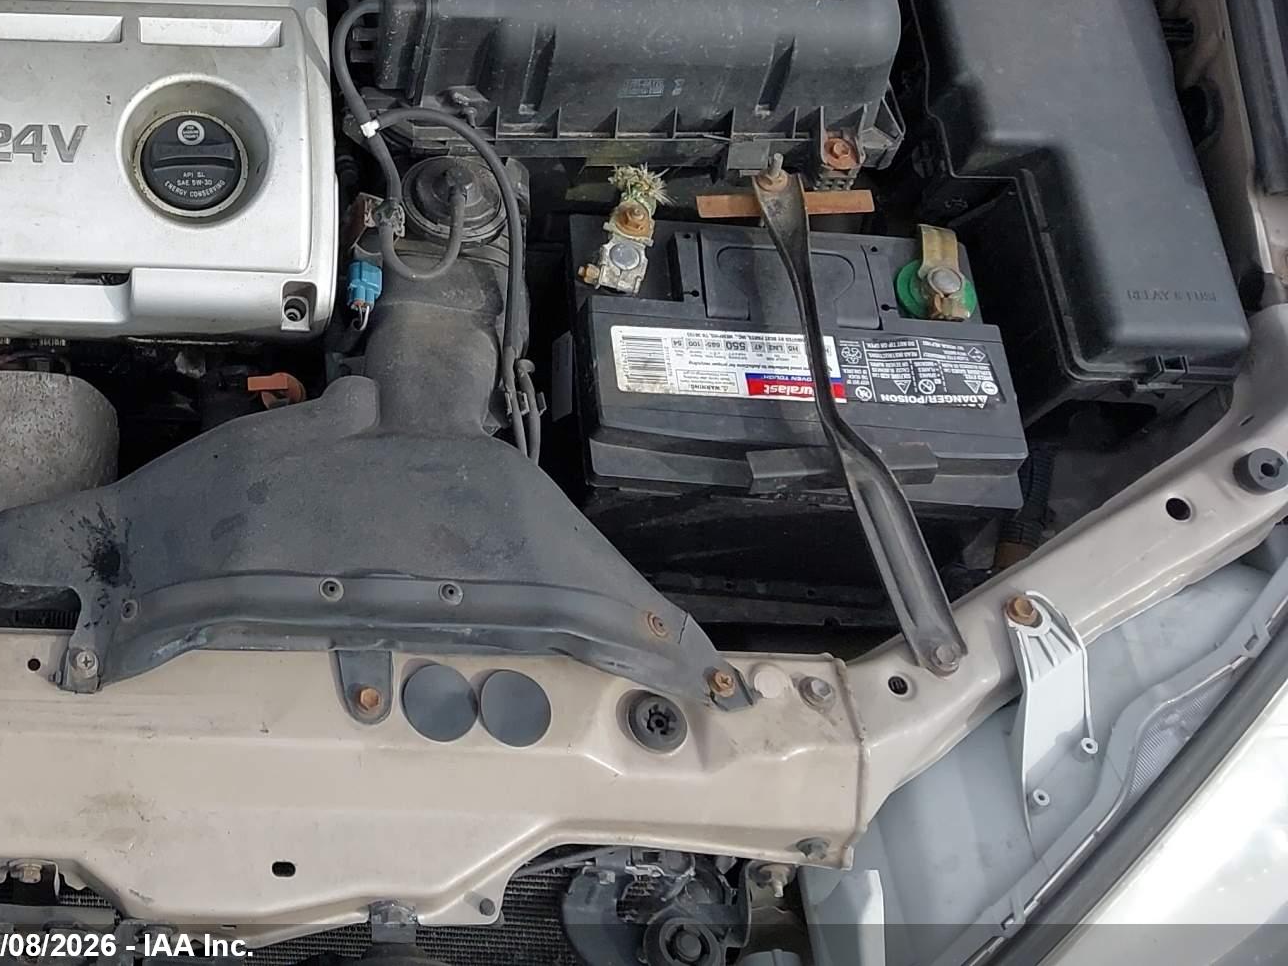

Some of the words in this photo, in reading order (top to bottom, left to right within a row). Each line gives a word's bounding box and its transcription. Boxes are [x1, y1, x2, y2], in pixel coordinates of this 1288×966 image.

[164, 180, 187, 196] ENERGY
[189, 179, 226, 198] CONSERVING
[725, 341, 745, 351] 550
[763, 384, 814, 396] uralast
[880, 394, 977, 404] DANGER/POISON
